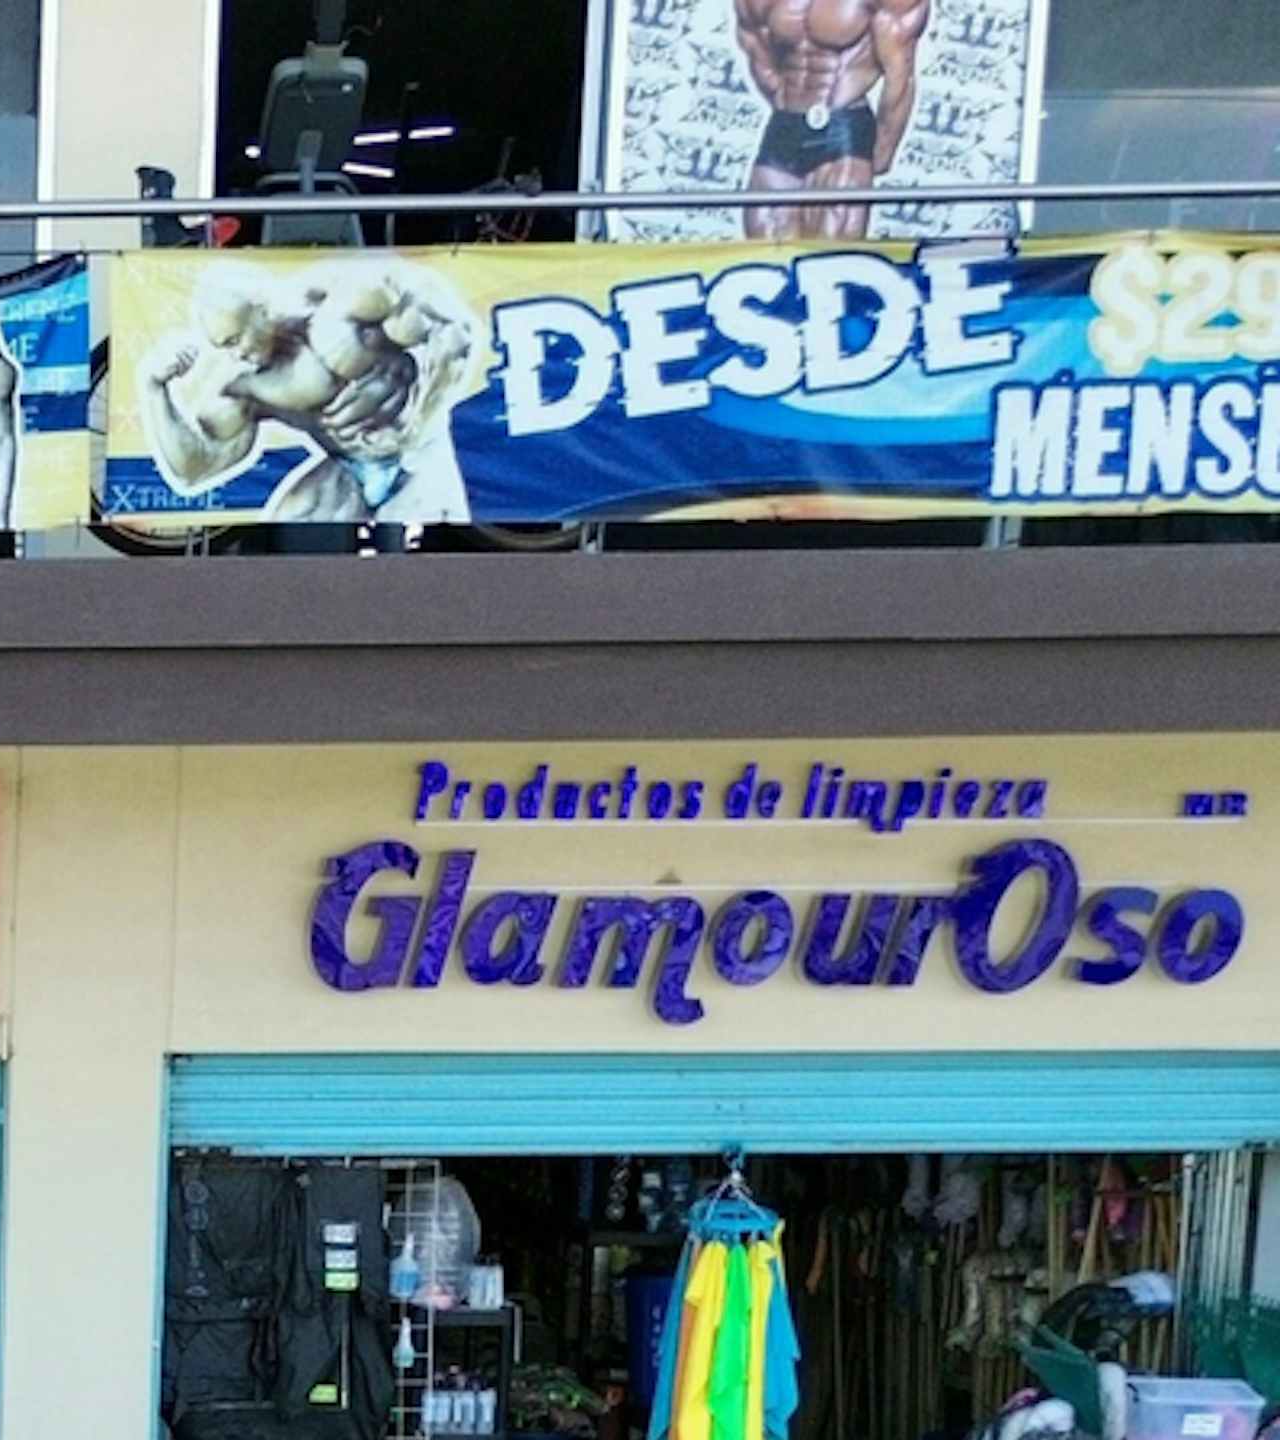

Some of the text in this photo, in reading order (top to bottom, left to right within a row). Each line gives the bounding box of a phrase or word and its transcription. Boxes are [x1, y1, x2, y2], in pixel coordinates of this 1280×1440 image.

[494, 242, 1020, 436] DESDE
[416, 761, 704, 821] Productos
[724, 764, 782, 819] de
[800, 762, 1048, 832] limpieza
[308, 838, 1246, 1025] GlamourOso
